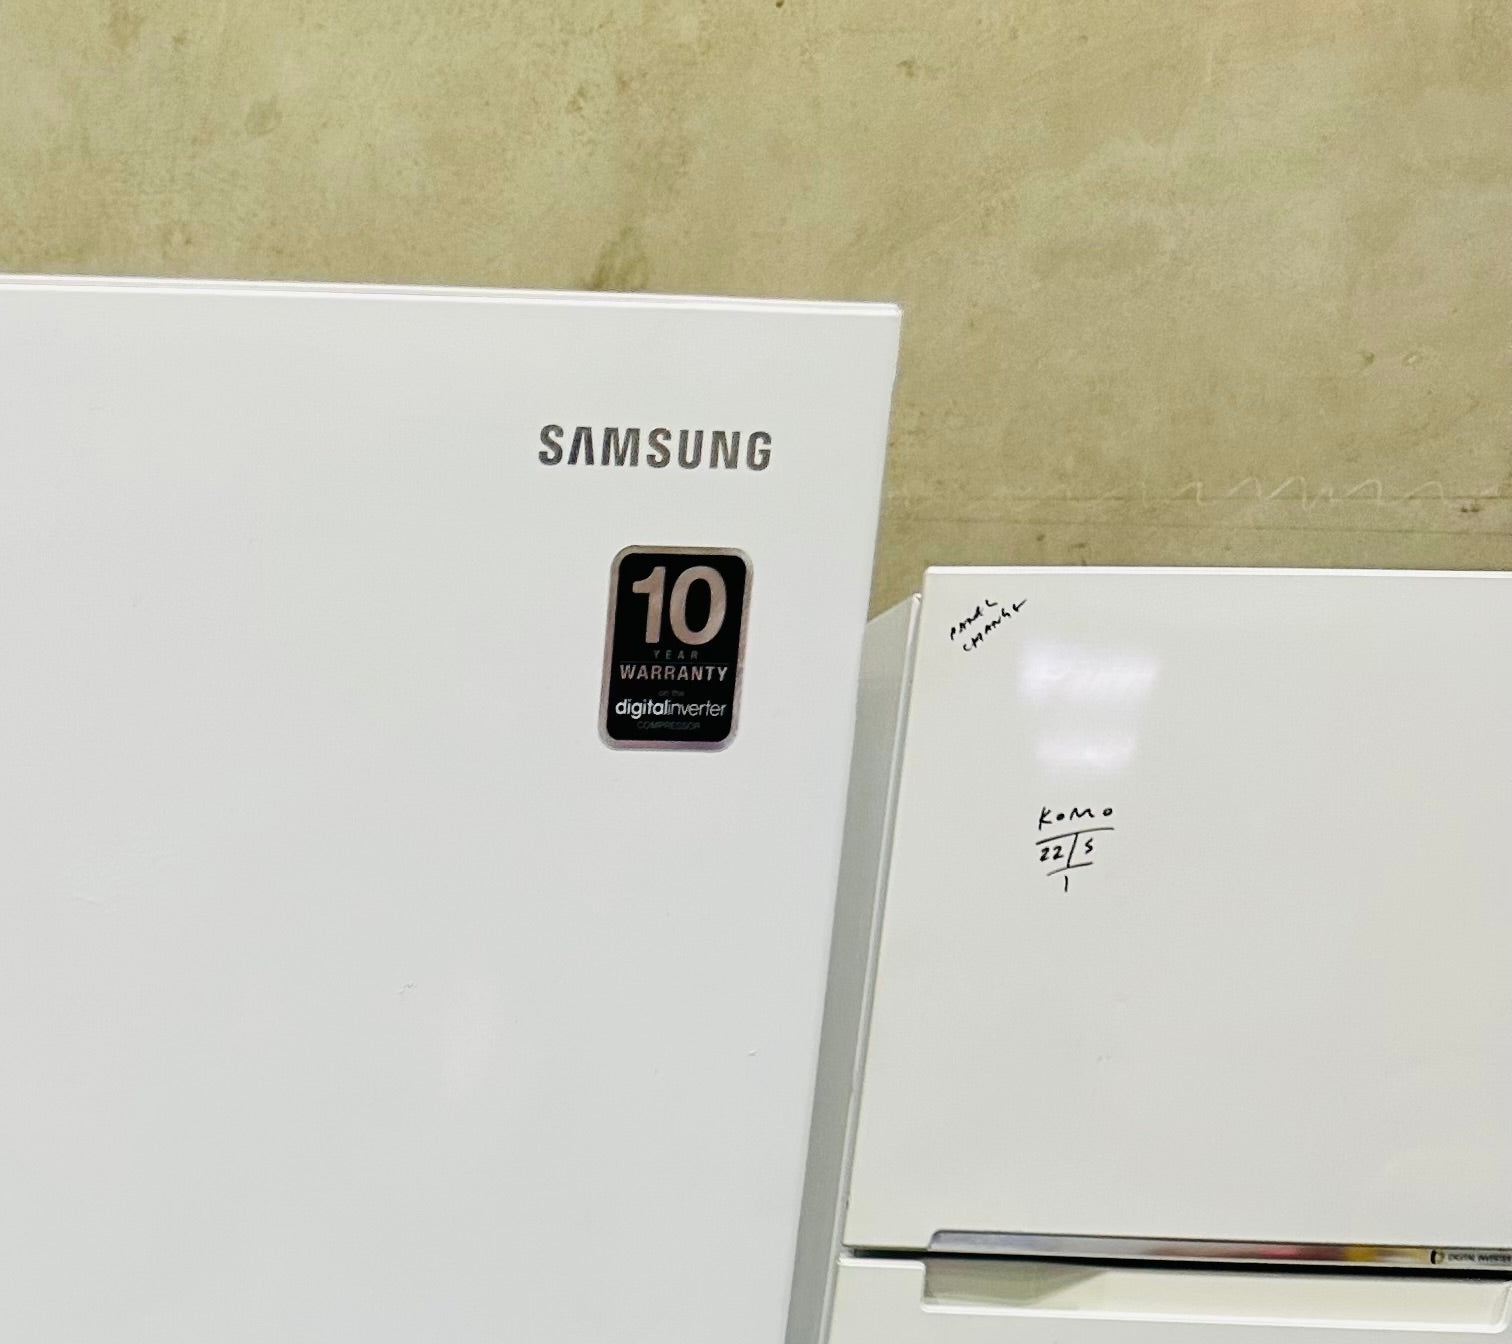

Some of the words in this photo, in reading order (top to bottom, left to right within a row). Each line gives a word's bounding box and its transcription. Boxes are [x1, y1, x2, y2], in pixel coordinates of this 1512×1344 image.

[538, 424, 773, 471] SAMSUNG
[632, 565, 727, 645] 10
[653, 649, 699, 660] YEAR
[619, 664, 728, 681] WARRANTY
